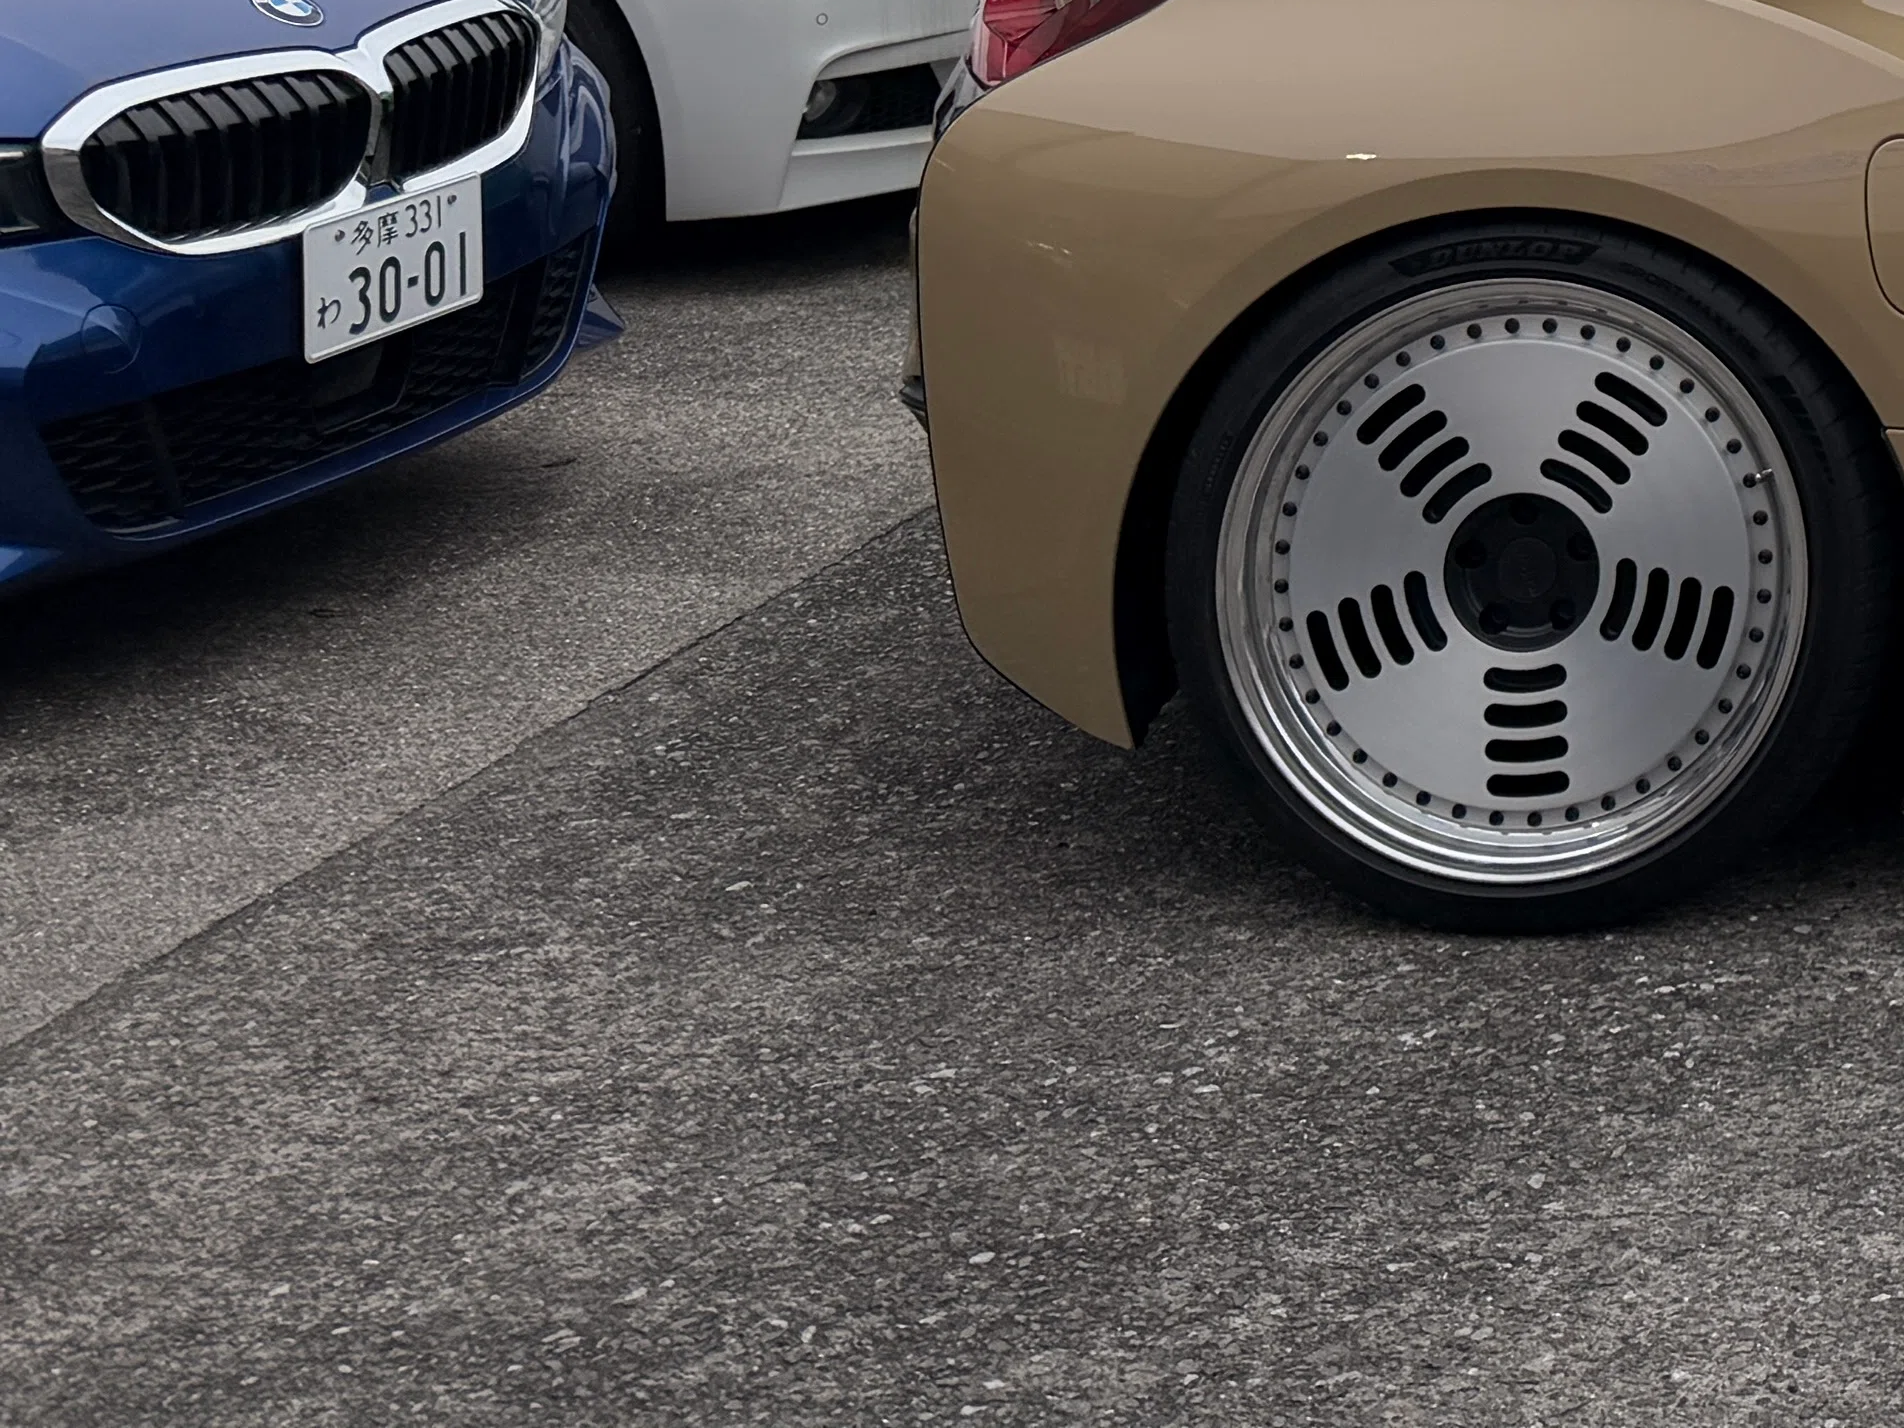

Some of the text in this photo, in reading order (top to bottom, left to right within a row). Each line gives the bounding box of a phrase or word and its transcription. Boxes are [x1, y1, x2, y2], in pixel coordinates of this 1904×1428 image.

[351, 195, 442, 255] 多摩 331
[1427, 240, 1584, 269] DUNLOP
[317, 231, 466, 335] わ 30-01
